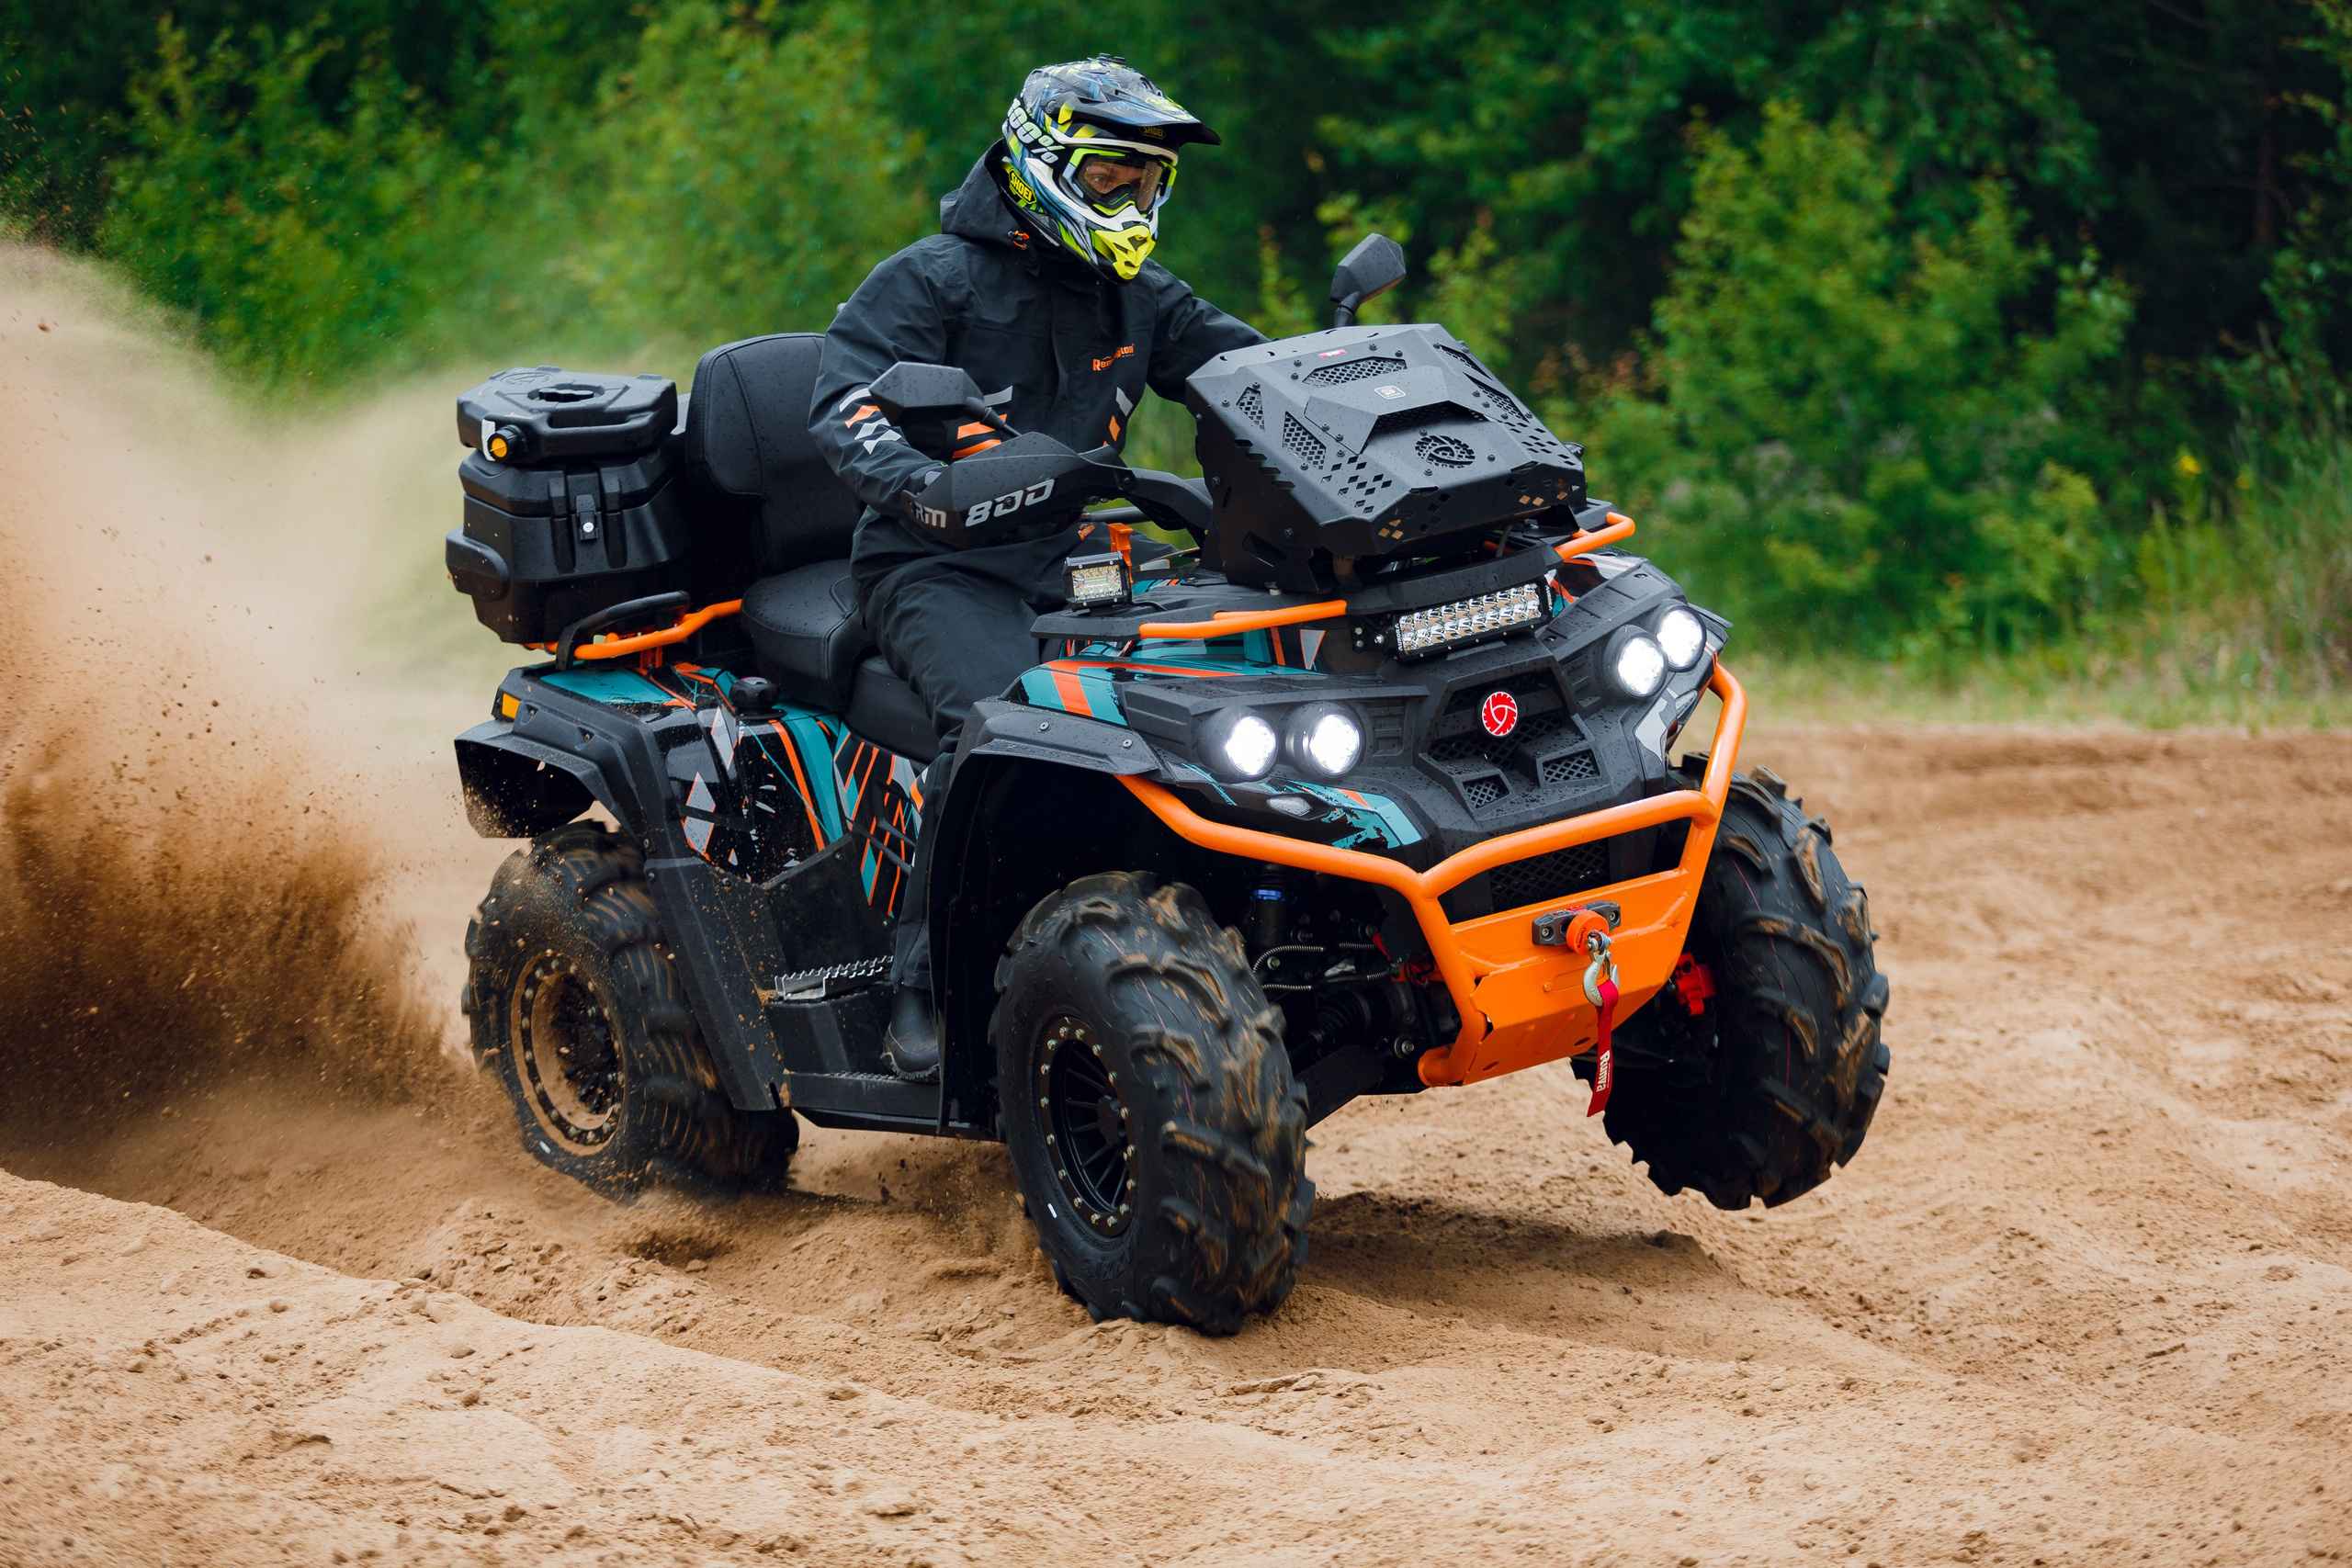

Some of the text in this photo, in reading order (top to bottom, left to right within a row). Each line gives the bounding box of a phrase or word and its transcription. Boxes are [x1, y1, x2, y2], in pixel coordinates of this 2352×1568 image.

[1007, 97, 1066, 164] 100%
[1143, 126, 1164, 138] SHOEI
[1010, 172, 1033, 201] SHOEI
[965, 479, 1055, 527] 800
[1596, 1049, 1611, 1092] Runva
